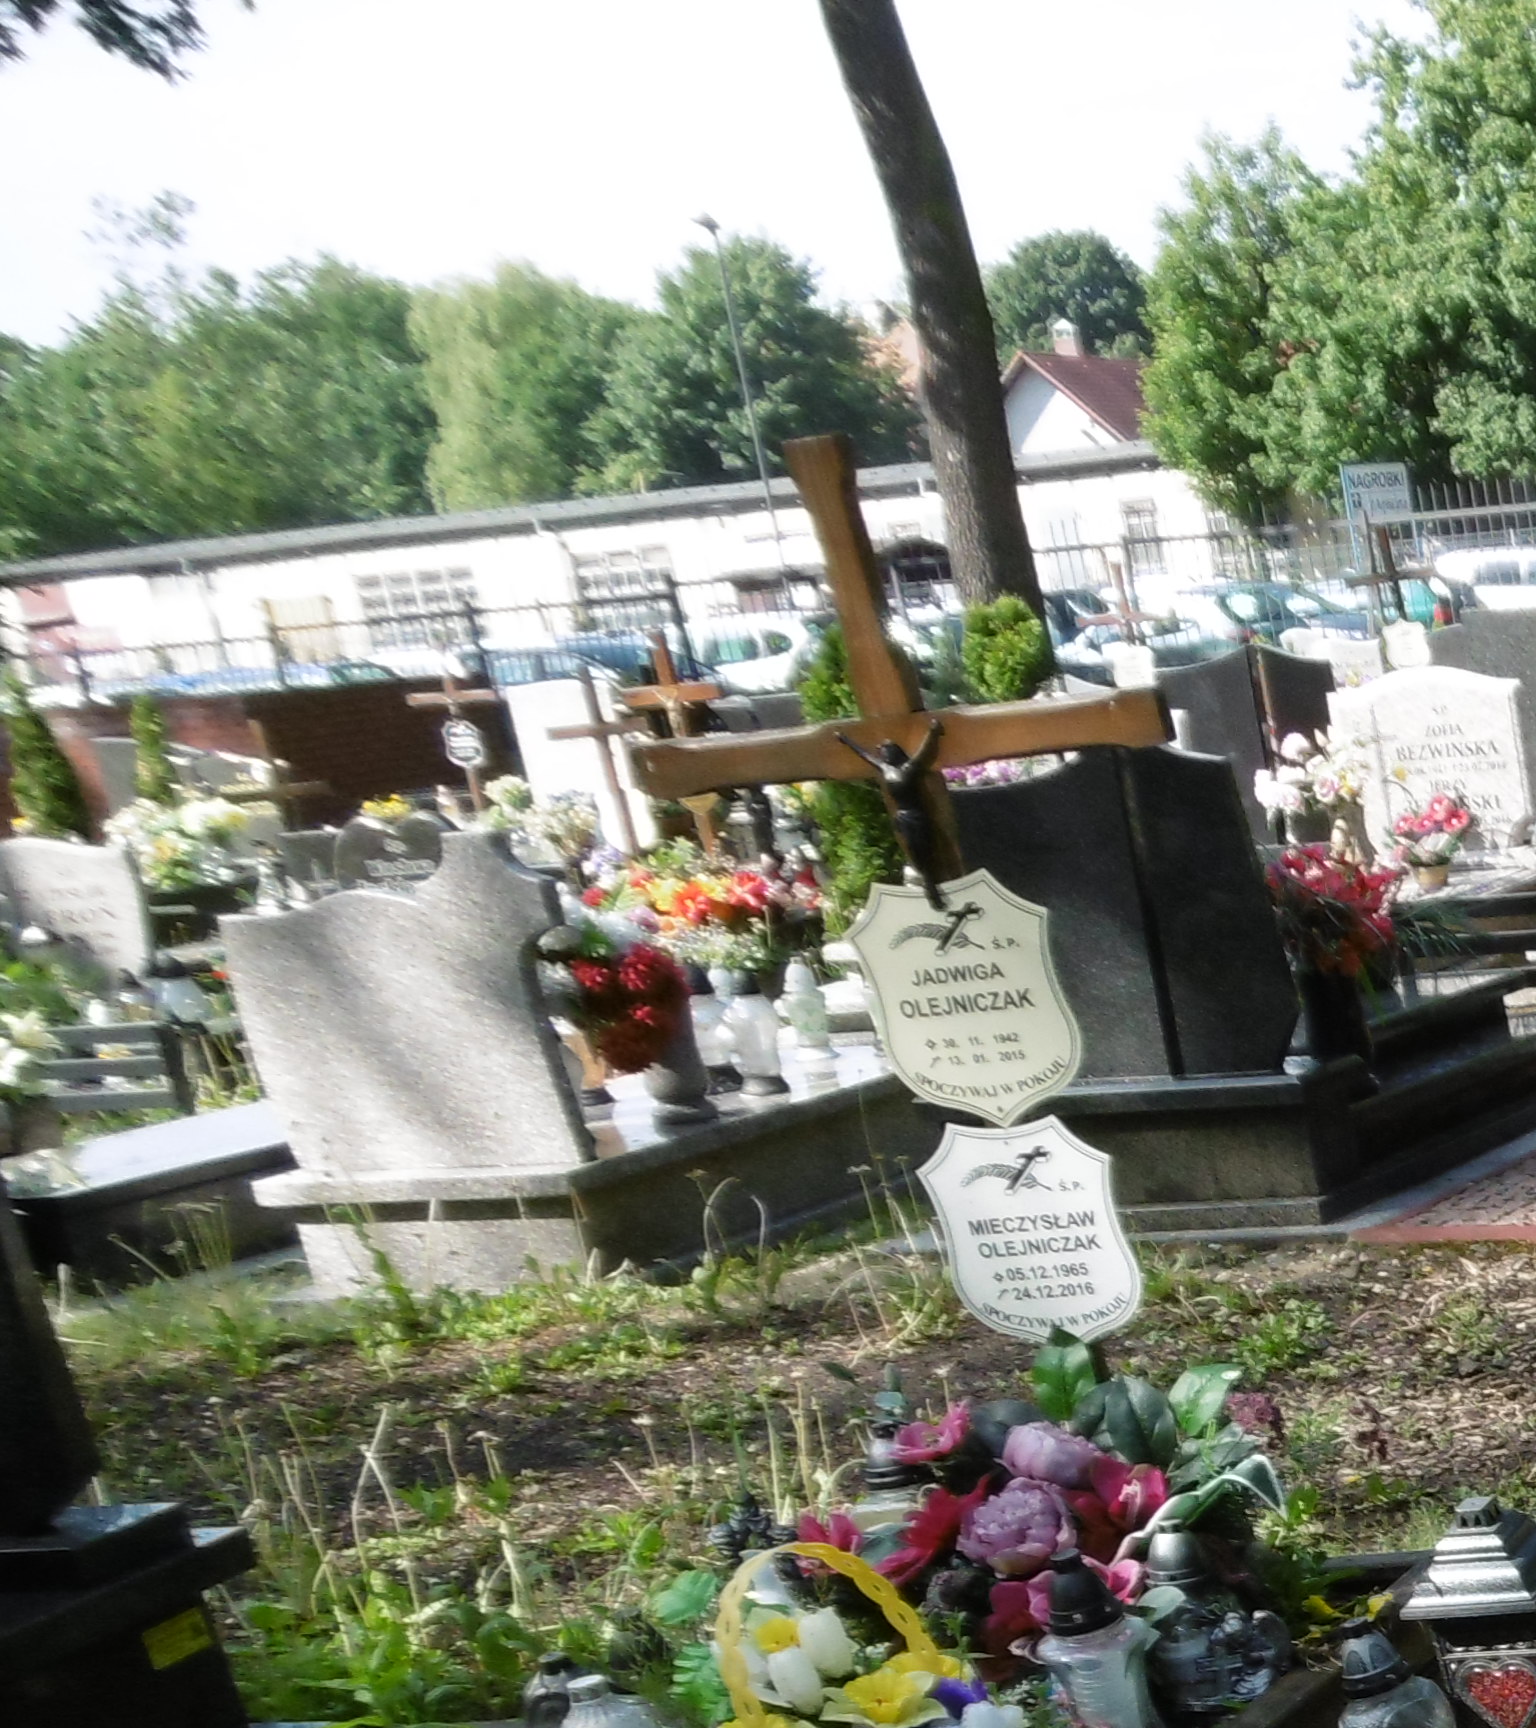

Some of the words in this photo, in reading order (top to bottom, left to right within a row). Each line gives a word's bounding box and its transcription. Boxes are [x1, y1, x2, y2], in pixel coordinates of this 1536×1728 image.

[1348, 472, 1404, 488] NAGROBKI
[1424, 722, 1464, 737] ZOFIA
[911, 962, 1005, 987] JADWIGA
[899, 988, 1036, 1019] OLEJNICZAK
[998, 1050, 1026, 1063] 2015
[914, 1072, 998, 1098] SPOCZYWAJ
[999, 1082, 1013, 1095] W
[1017, 1055, 1067, 1092] POKOJU
[968, 1210, 1096, 1236] MIECZYSŁAW
[978, 1234, 1102, 1259] OLEJNICZAK
[1005, 1262, 1089, 1281] 05.12.1965
[1012, 1282, 1095, 1301] 24.12.2016
[1081, 1292, 1129, 1324] POKOJU
